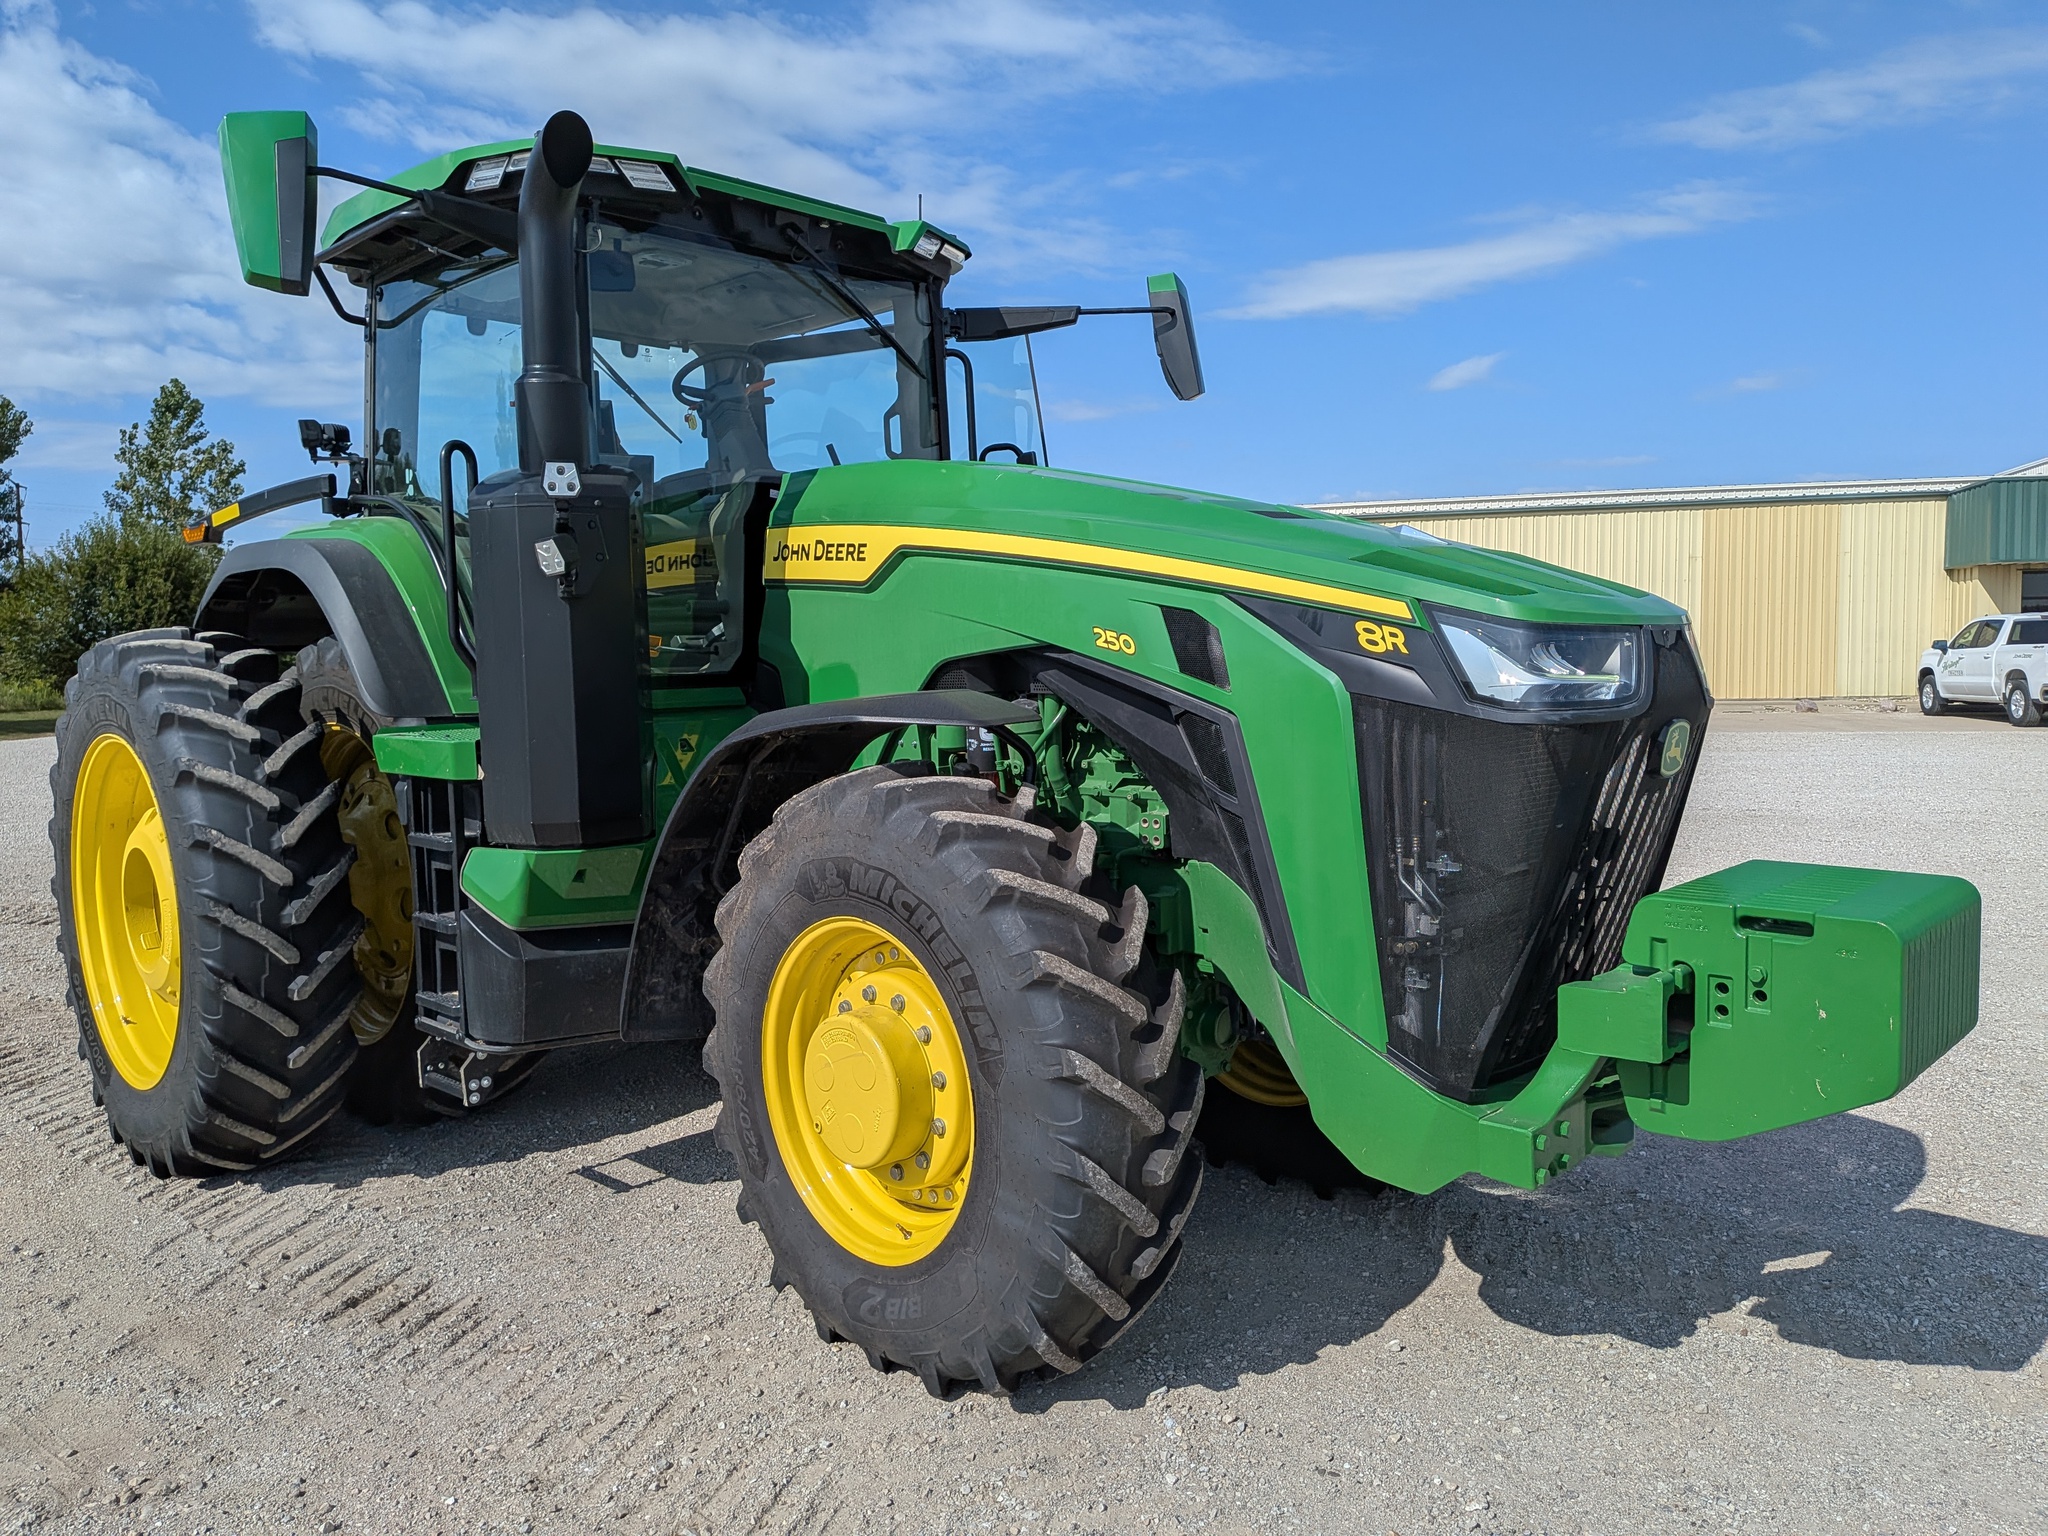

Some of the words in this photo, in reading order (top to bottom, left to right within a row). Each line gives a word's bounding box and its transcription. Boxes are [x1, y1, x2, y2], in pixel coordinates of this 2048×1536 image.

[773, 540, 811, 562] JOHN
[813, 539, 868, 562] DEERE
[1092, 625, 1137, 656] 250
[1355, 620, 1409, 655] 8R
[850, 861, 1004, 1058] MICHELIN
